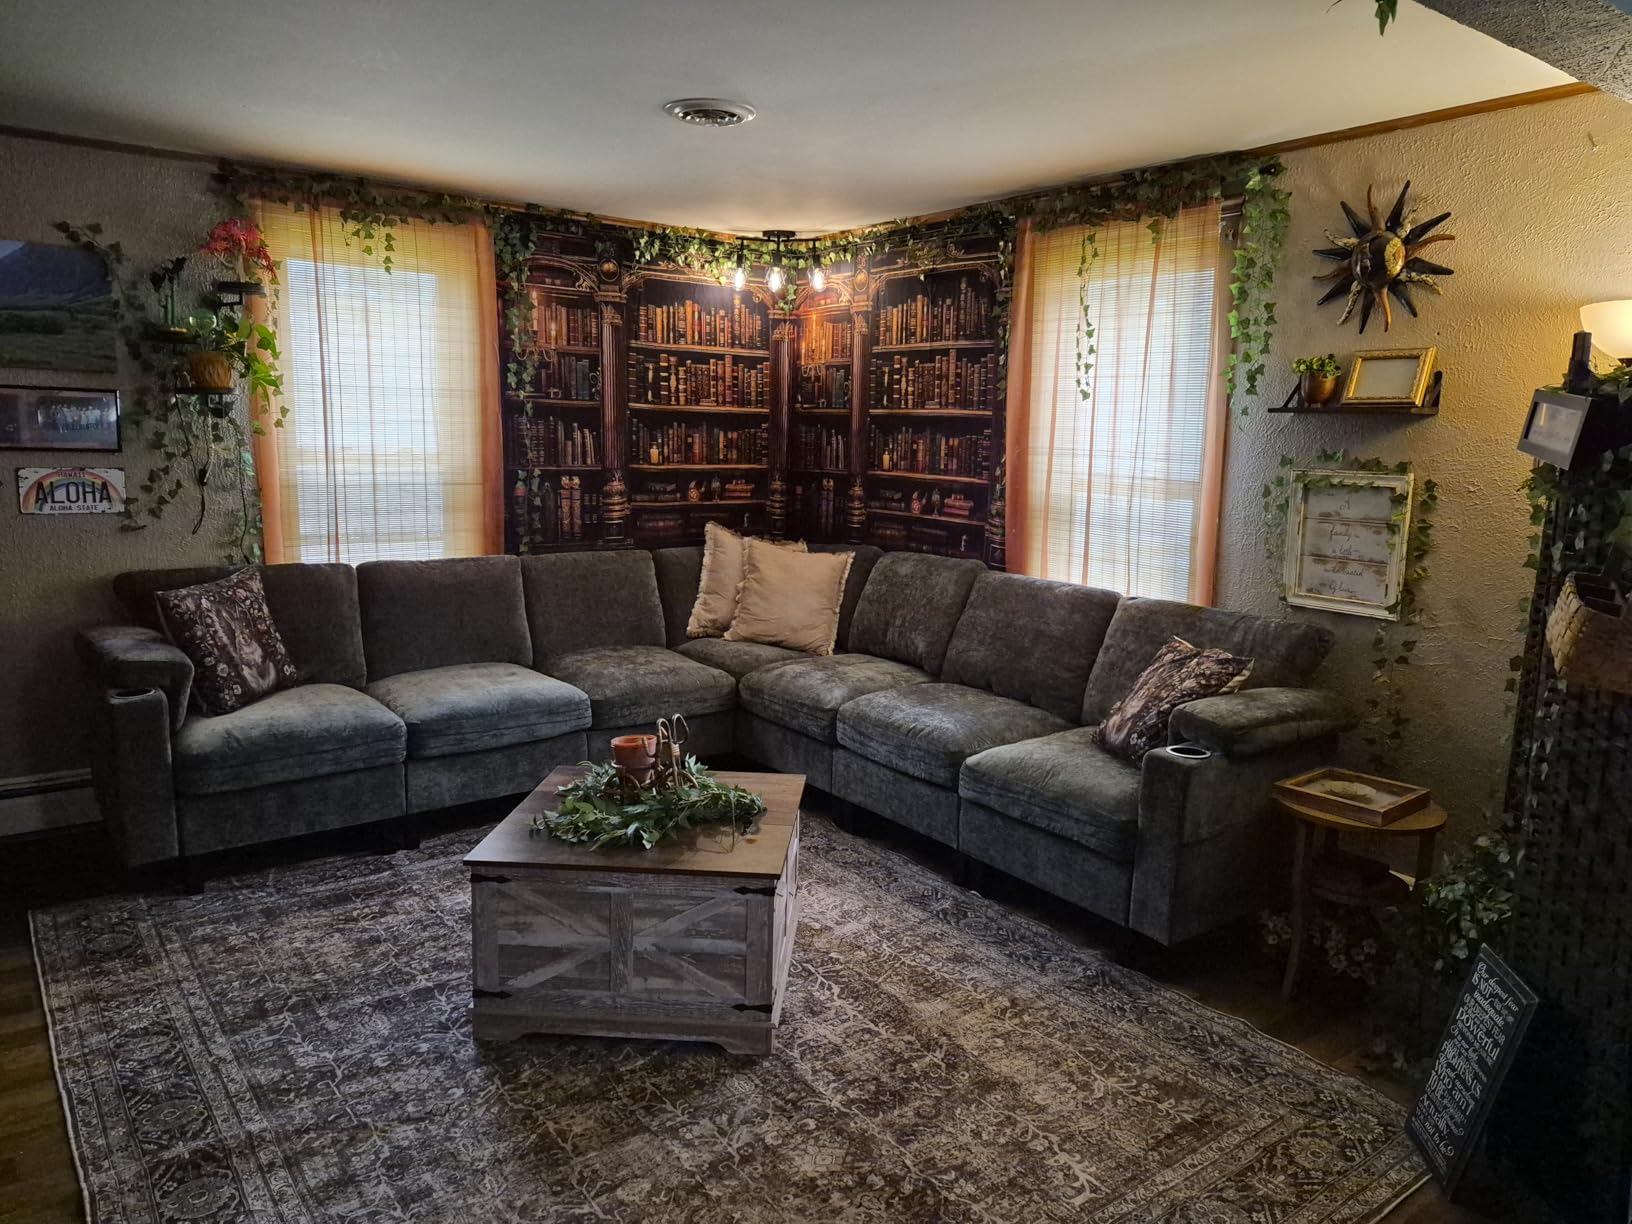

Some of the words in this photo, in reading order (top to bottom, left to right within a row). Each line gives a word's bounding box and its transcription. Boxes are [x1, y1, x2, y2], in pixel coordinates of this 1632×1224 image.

[35, 481, 112, 504] ALOHA
[1478, 978, 1492, 998] NOT
[1456, 1007, 1500, 1061] powerful
[1428, 1070, 1438, 1090] TO
[1435, 1081, 1446, 1099] BE
[1452, 1088, 1466, 1109] am
